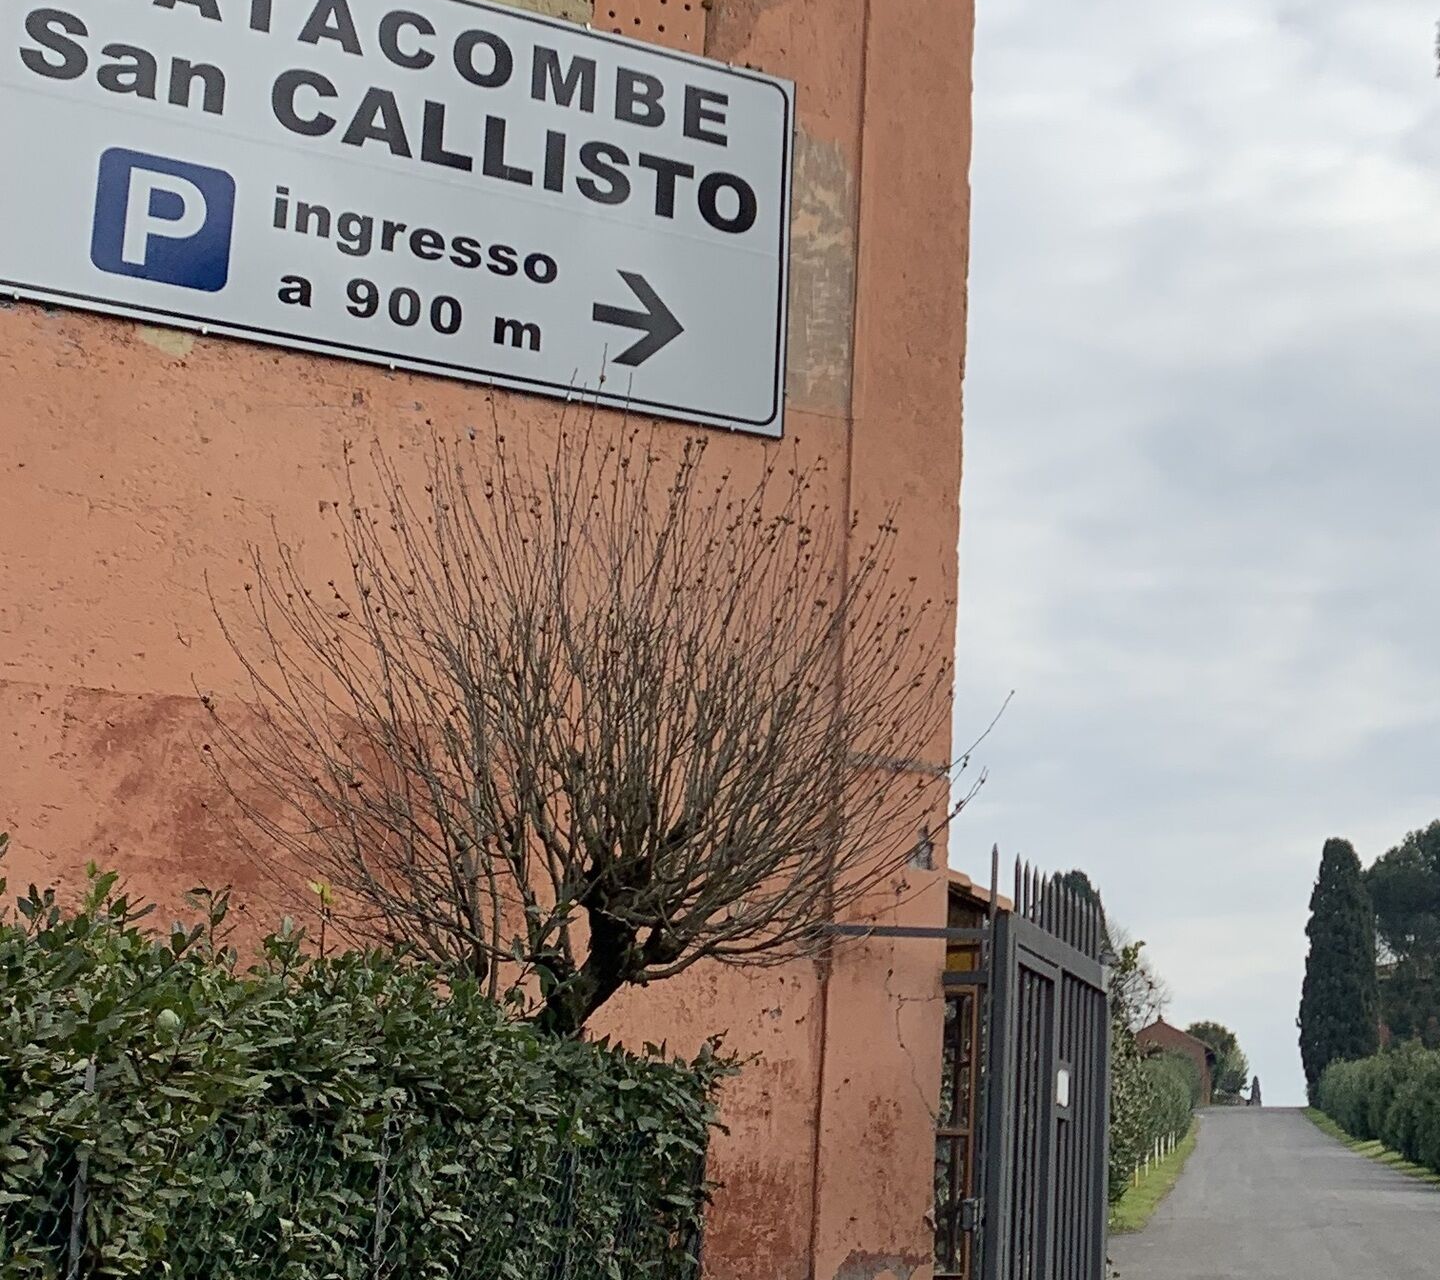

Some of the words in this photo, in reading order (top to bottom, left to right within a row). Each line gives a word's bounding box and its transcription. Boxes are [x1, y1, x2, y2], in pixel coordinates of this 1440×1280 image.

[19, 8, 227, 117] San
[271, 69, 758, 235] CALLISTO
[121, 165, 208, 267] P
[273, 186, 559, 284] ingresso
[277, 275, 312, 308] a
[346, 278, 463, 335] 900
[493, 314, 541, 352] m
